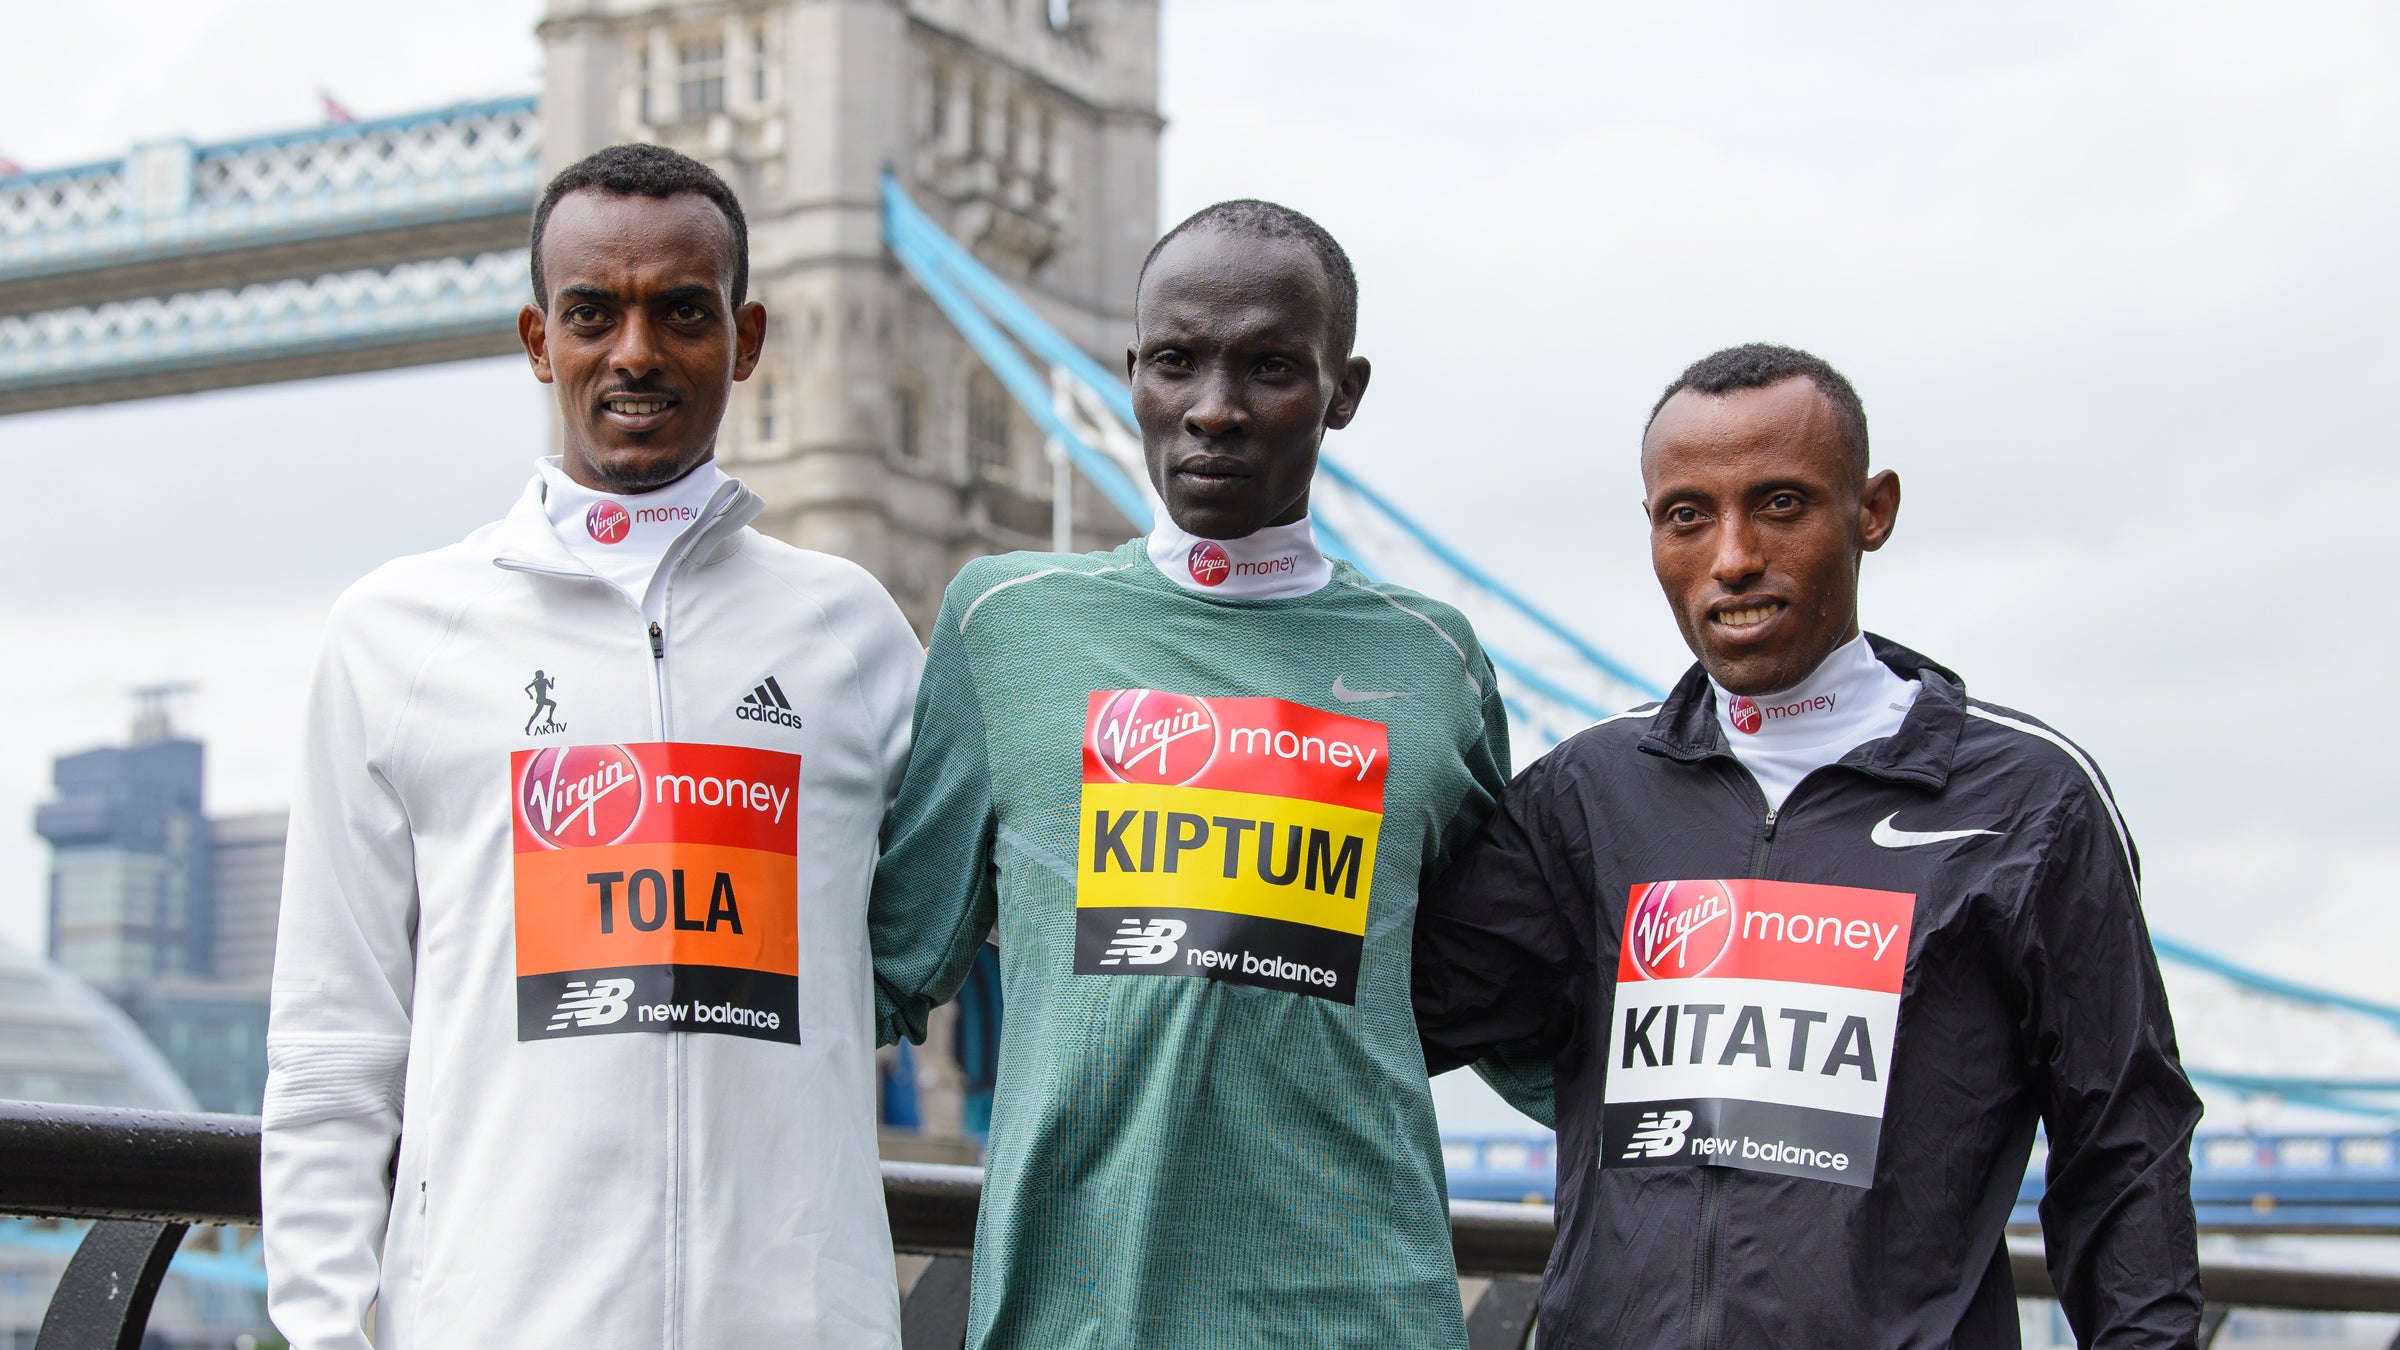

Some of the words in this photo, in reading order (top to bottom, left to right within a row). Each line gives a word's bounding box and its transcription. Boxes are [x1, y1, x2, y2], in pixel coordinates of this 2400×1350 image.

[590, 505, 626, 538] Virgin
[1192, 546, 1227, 581] Virgin
[1236, 555, 1297, 576] money
[736, 704, 802, 729] adidas
[1731, 696, 1757, 729] Virgin
[1766, 693, 1836, 719] money
[1104, 689, 1210, 775] Virgin
[1229, 726, 1377, 781] money
[530, 745, 634, 836] Virgin
[656, 774, 790, 824] money
[1093, 810, 1364, 900] KIPTUM
[587, 868, 743, 935] TOLA
[1638, 881, 1727, 969] Virgin
[1743, 911, 1898, 961] money
[1186, 948, 1237, 970] new
[1243, 952, 1337, 987] balance
[638, 1002, 689, 1022] new
[695, 1000, 780, 1030] balance
[1622, 1004, 1878, 1082] KITATA
[1692, 1136, 1737, 1155] new
[1742, 1136, 1849, 1171] balance
